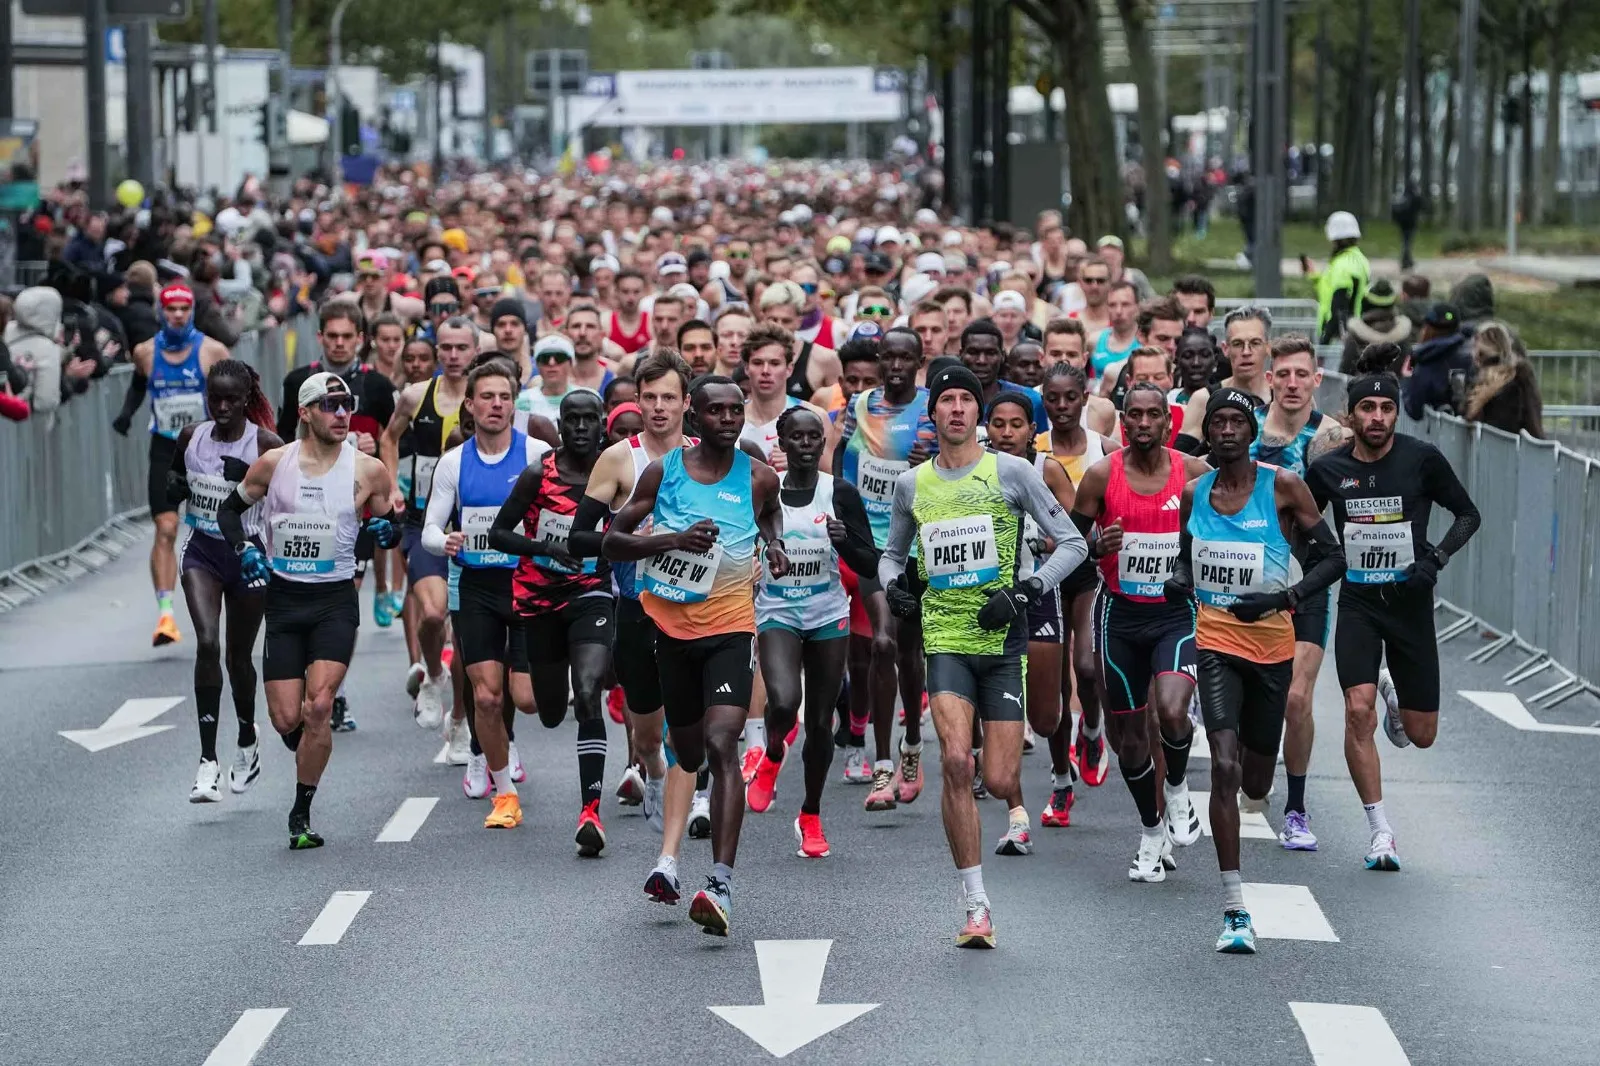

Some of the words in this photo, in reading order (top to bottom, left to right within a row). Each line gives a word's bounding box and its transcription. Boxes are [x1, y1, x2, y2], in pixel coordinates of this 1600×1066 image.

[862, 474, 888, 495] PACE
[717, 491, 742, 504] HOKA
[1347, 498, 1400, 510] DRESCHER
[288, 521, 330, 530] mainova
[1242, 519, 1269, 529] HOKA
[940, 524, 987, 539] mainova
[1362, 531, 1406, 541] mainova
[283, 541, 321, 558] 5335
[933, 543, 967, 567] PACE
[971, 540, 987, 561] W
[1209, 549, 1257, 561] mainova
[479, 553, 509, 564] HOKA
[1126, 556, 1162, 574] PACE
[1360, 551, 1397, 569] 10711
[286, 561, 317, 572] HOKA
[651, 552, 690, 579] PACE
[689, 563, 708, 584] W
[948, 572, 980, 587] HOKA
[1200, 564, 1235, 585] PACE
[1239, 568, 1254, 587] W
[1363, 572, 1396, 583] HOKA
[652, 583, 686, 602] HOKA
[782, 587, 812, 598] HOKA
